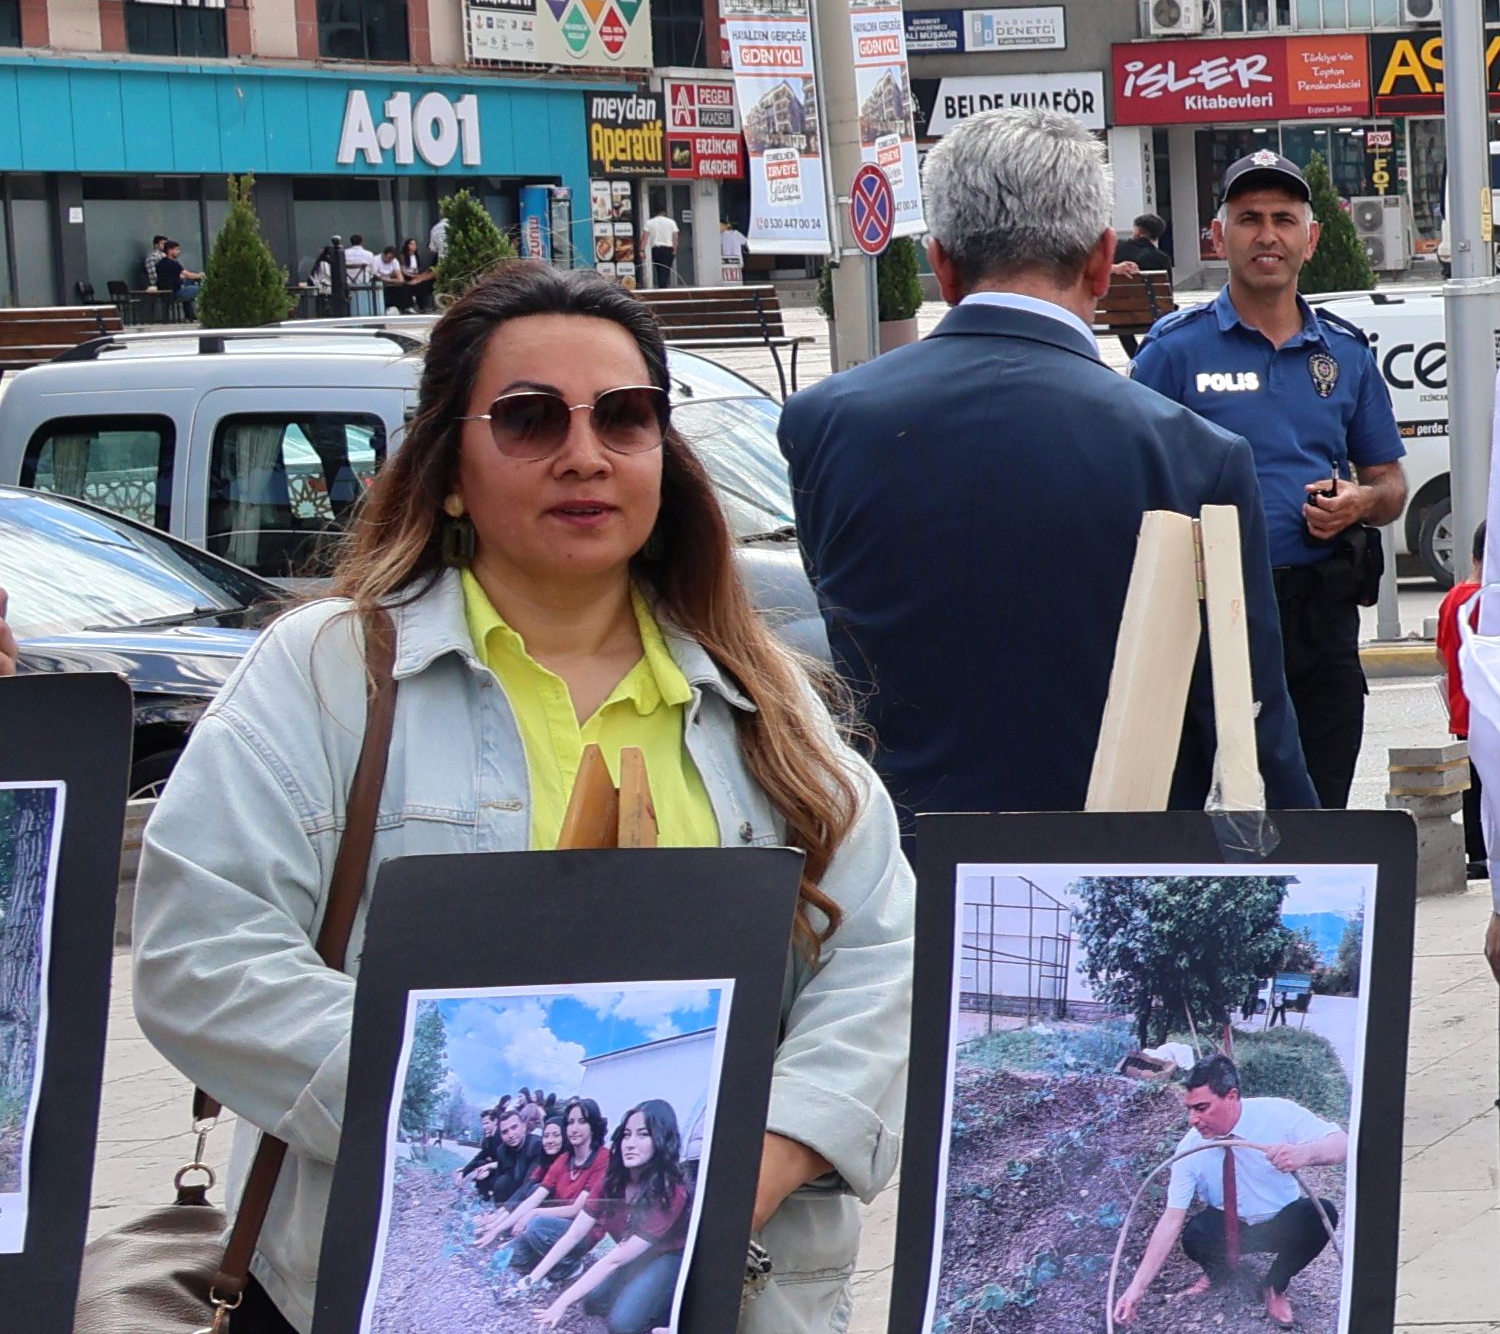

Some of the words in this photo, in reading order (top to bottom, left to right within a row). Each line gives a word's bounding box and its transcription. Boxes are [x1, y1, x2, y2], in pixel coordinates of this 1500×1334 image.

[1311, 67, 1345, 79] Toptan
[1297, 79, 1361, 91] Perakendecisi
[700, 88, 730, 104] PEGEM
[1184, 93, 1273, 110] Kitabevleri
[592, 95, 656, 123] meydan
[1308, 105, 1334, 114] Erzincan
[700, 111, 731, 125] AKADEMİ
[591, 120, 663, 172] Aperatif
[696, 136, 737, 155] ERZİNCAN
[699, 159, 737, 175] AKADEMİ
[784, 219, 798, 229] 447
[811, 218, 821, 229] 24
[1196, 372, 1259, 392] POLİS
